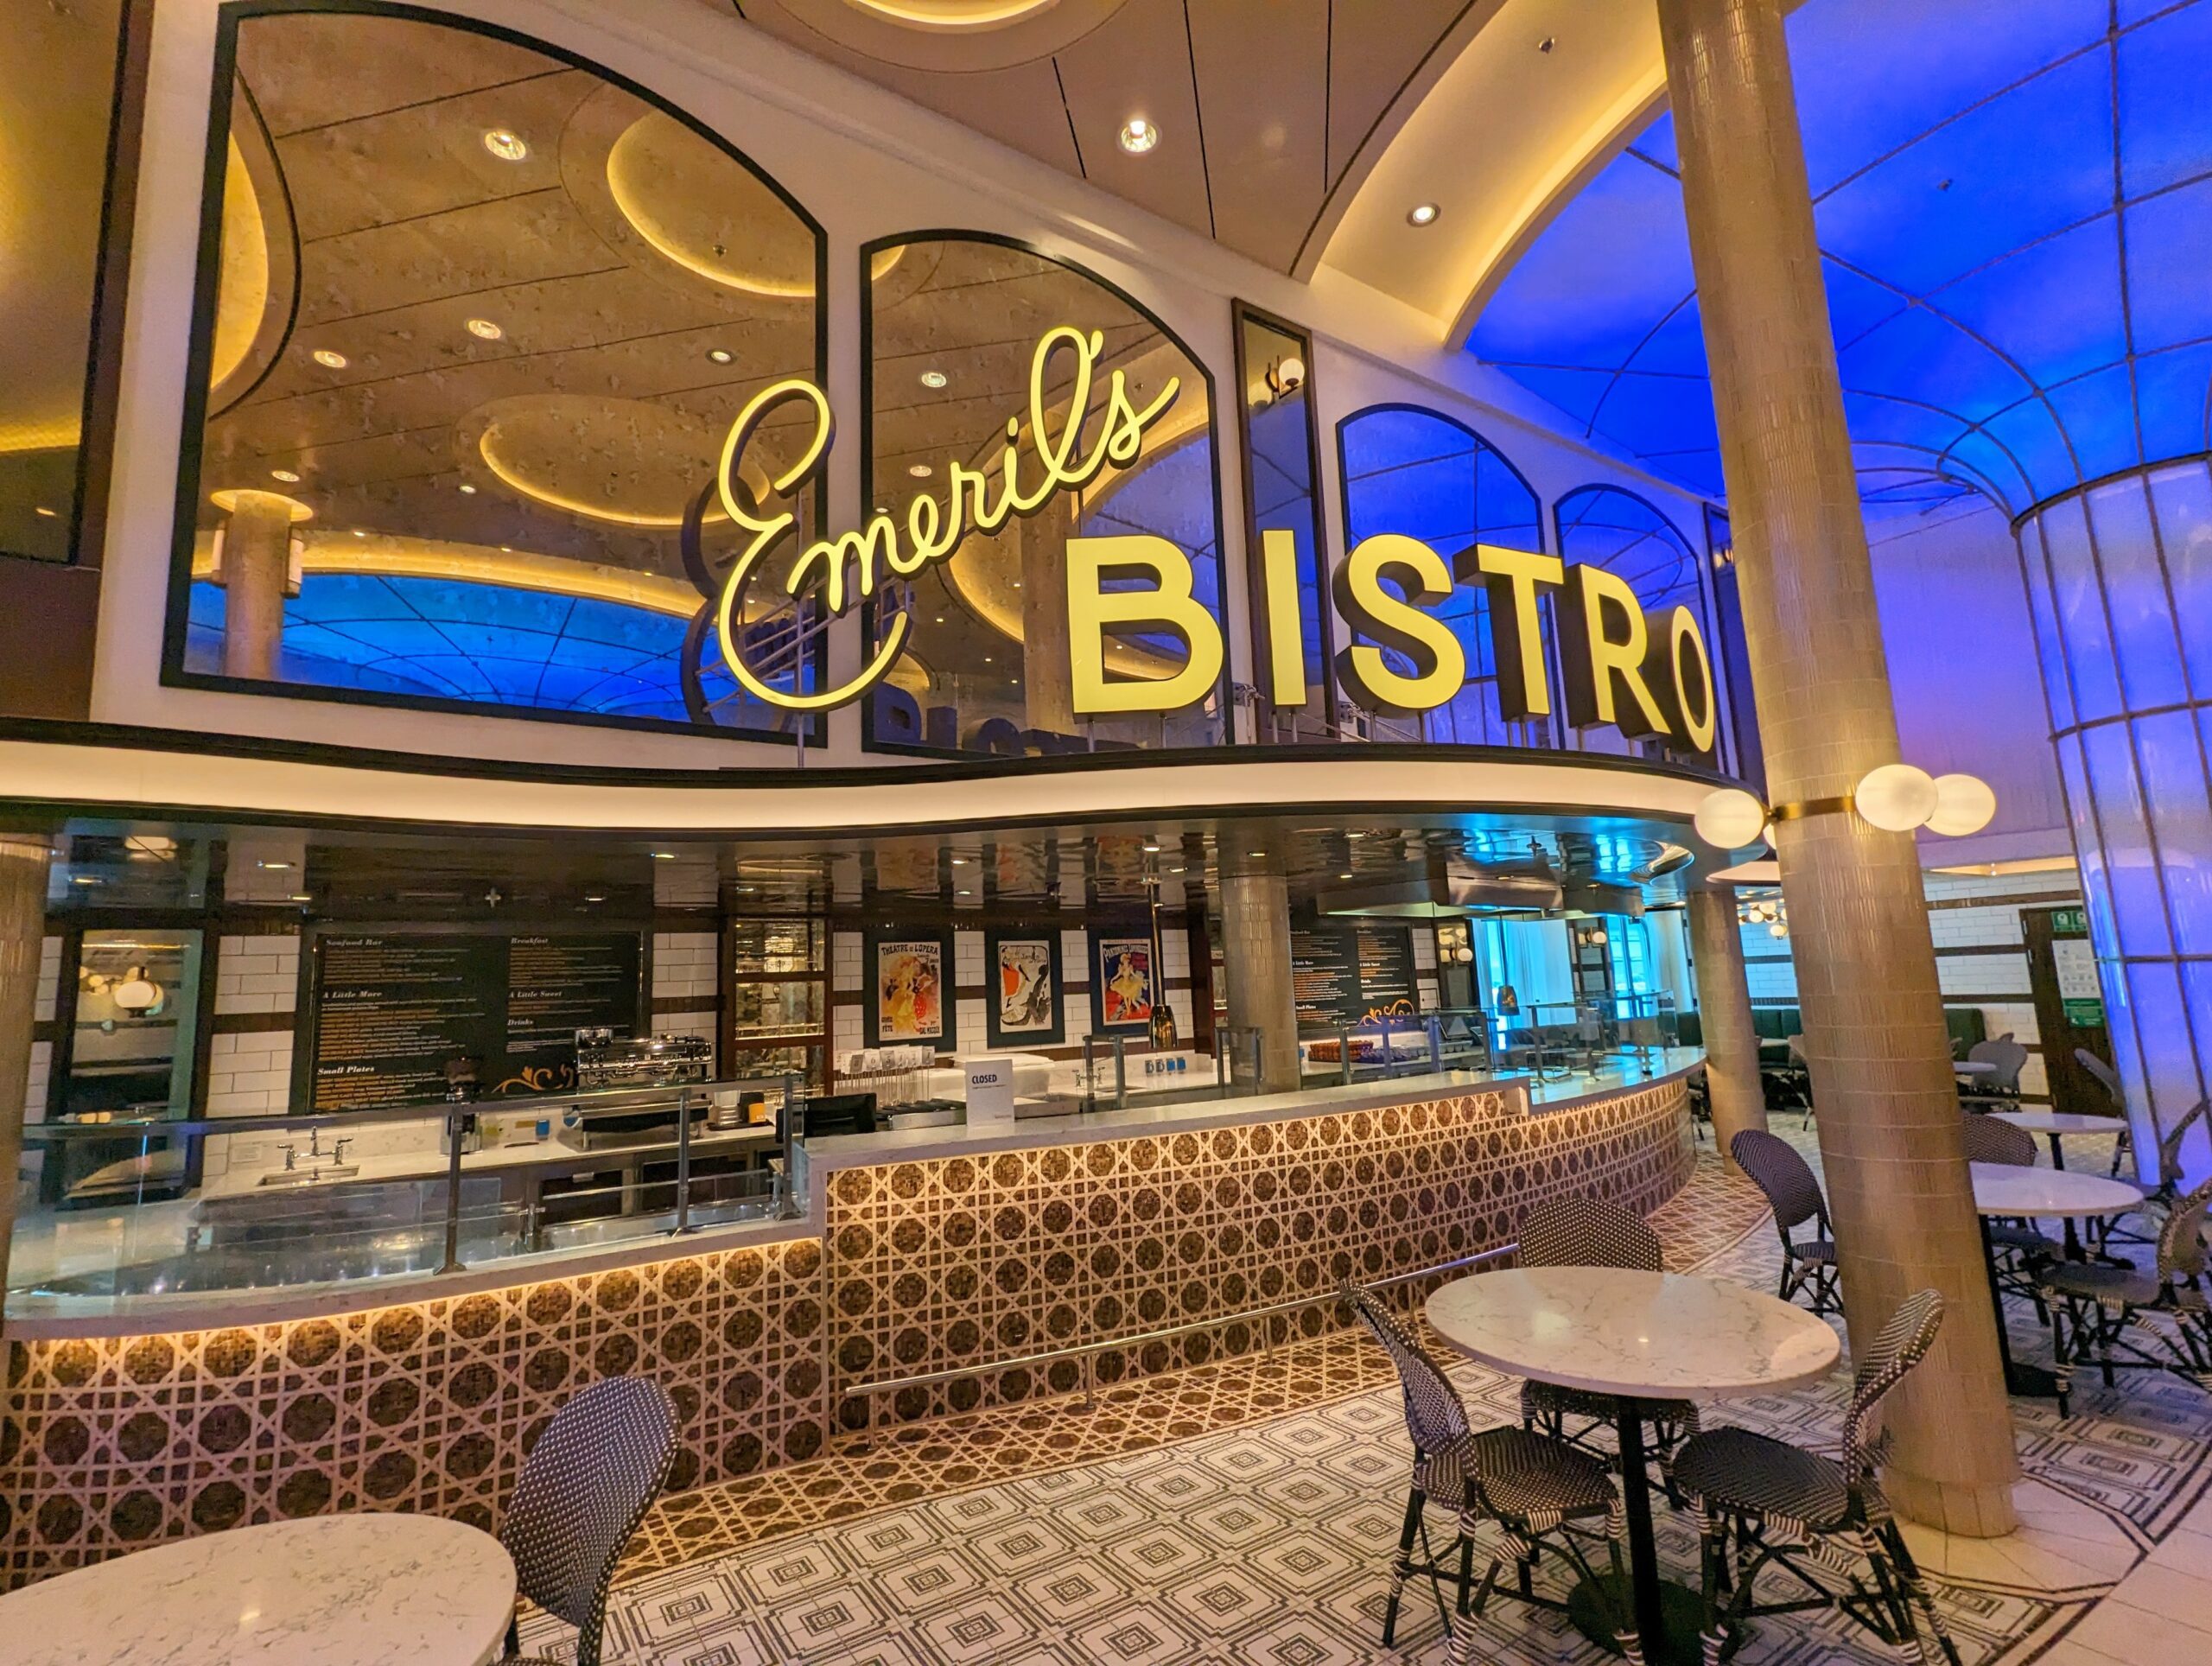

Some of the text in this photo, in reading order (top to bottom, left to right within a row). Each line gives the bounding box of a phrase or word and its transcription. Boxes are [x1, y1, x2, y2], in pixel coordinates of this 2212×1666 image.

[718, 325, 1180, 709] Emeril's
[1065, 529, 1715, 754] BISTRO
[971, 1074, 997, 1084] CLOSED
